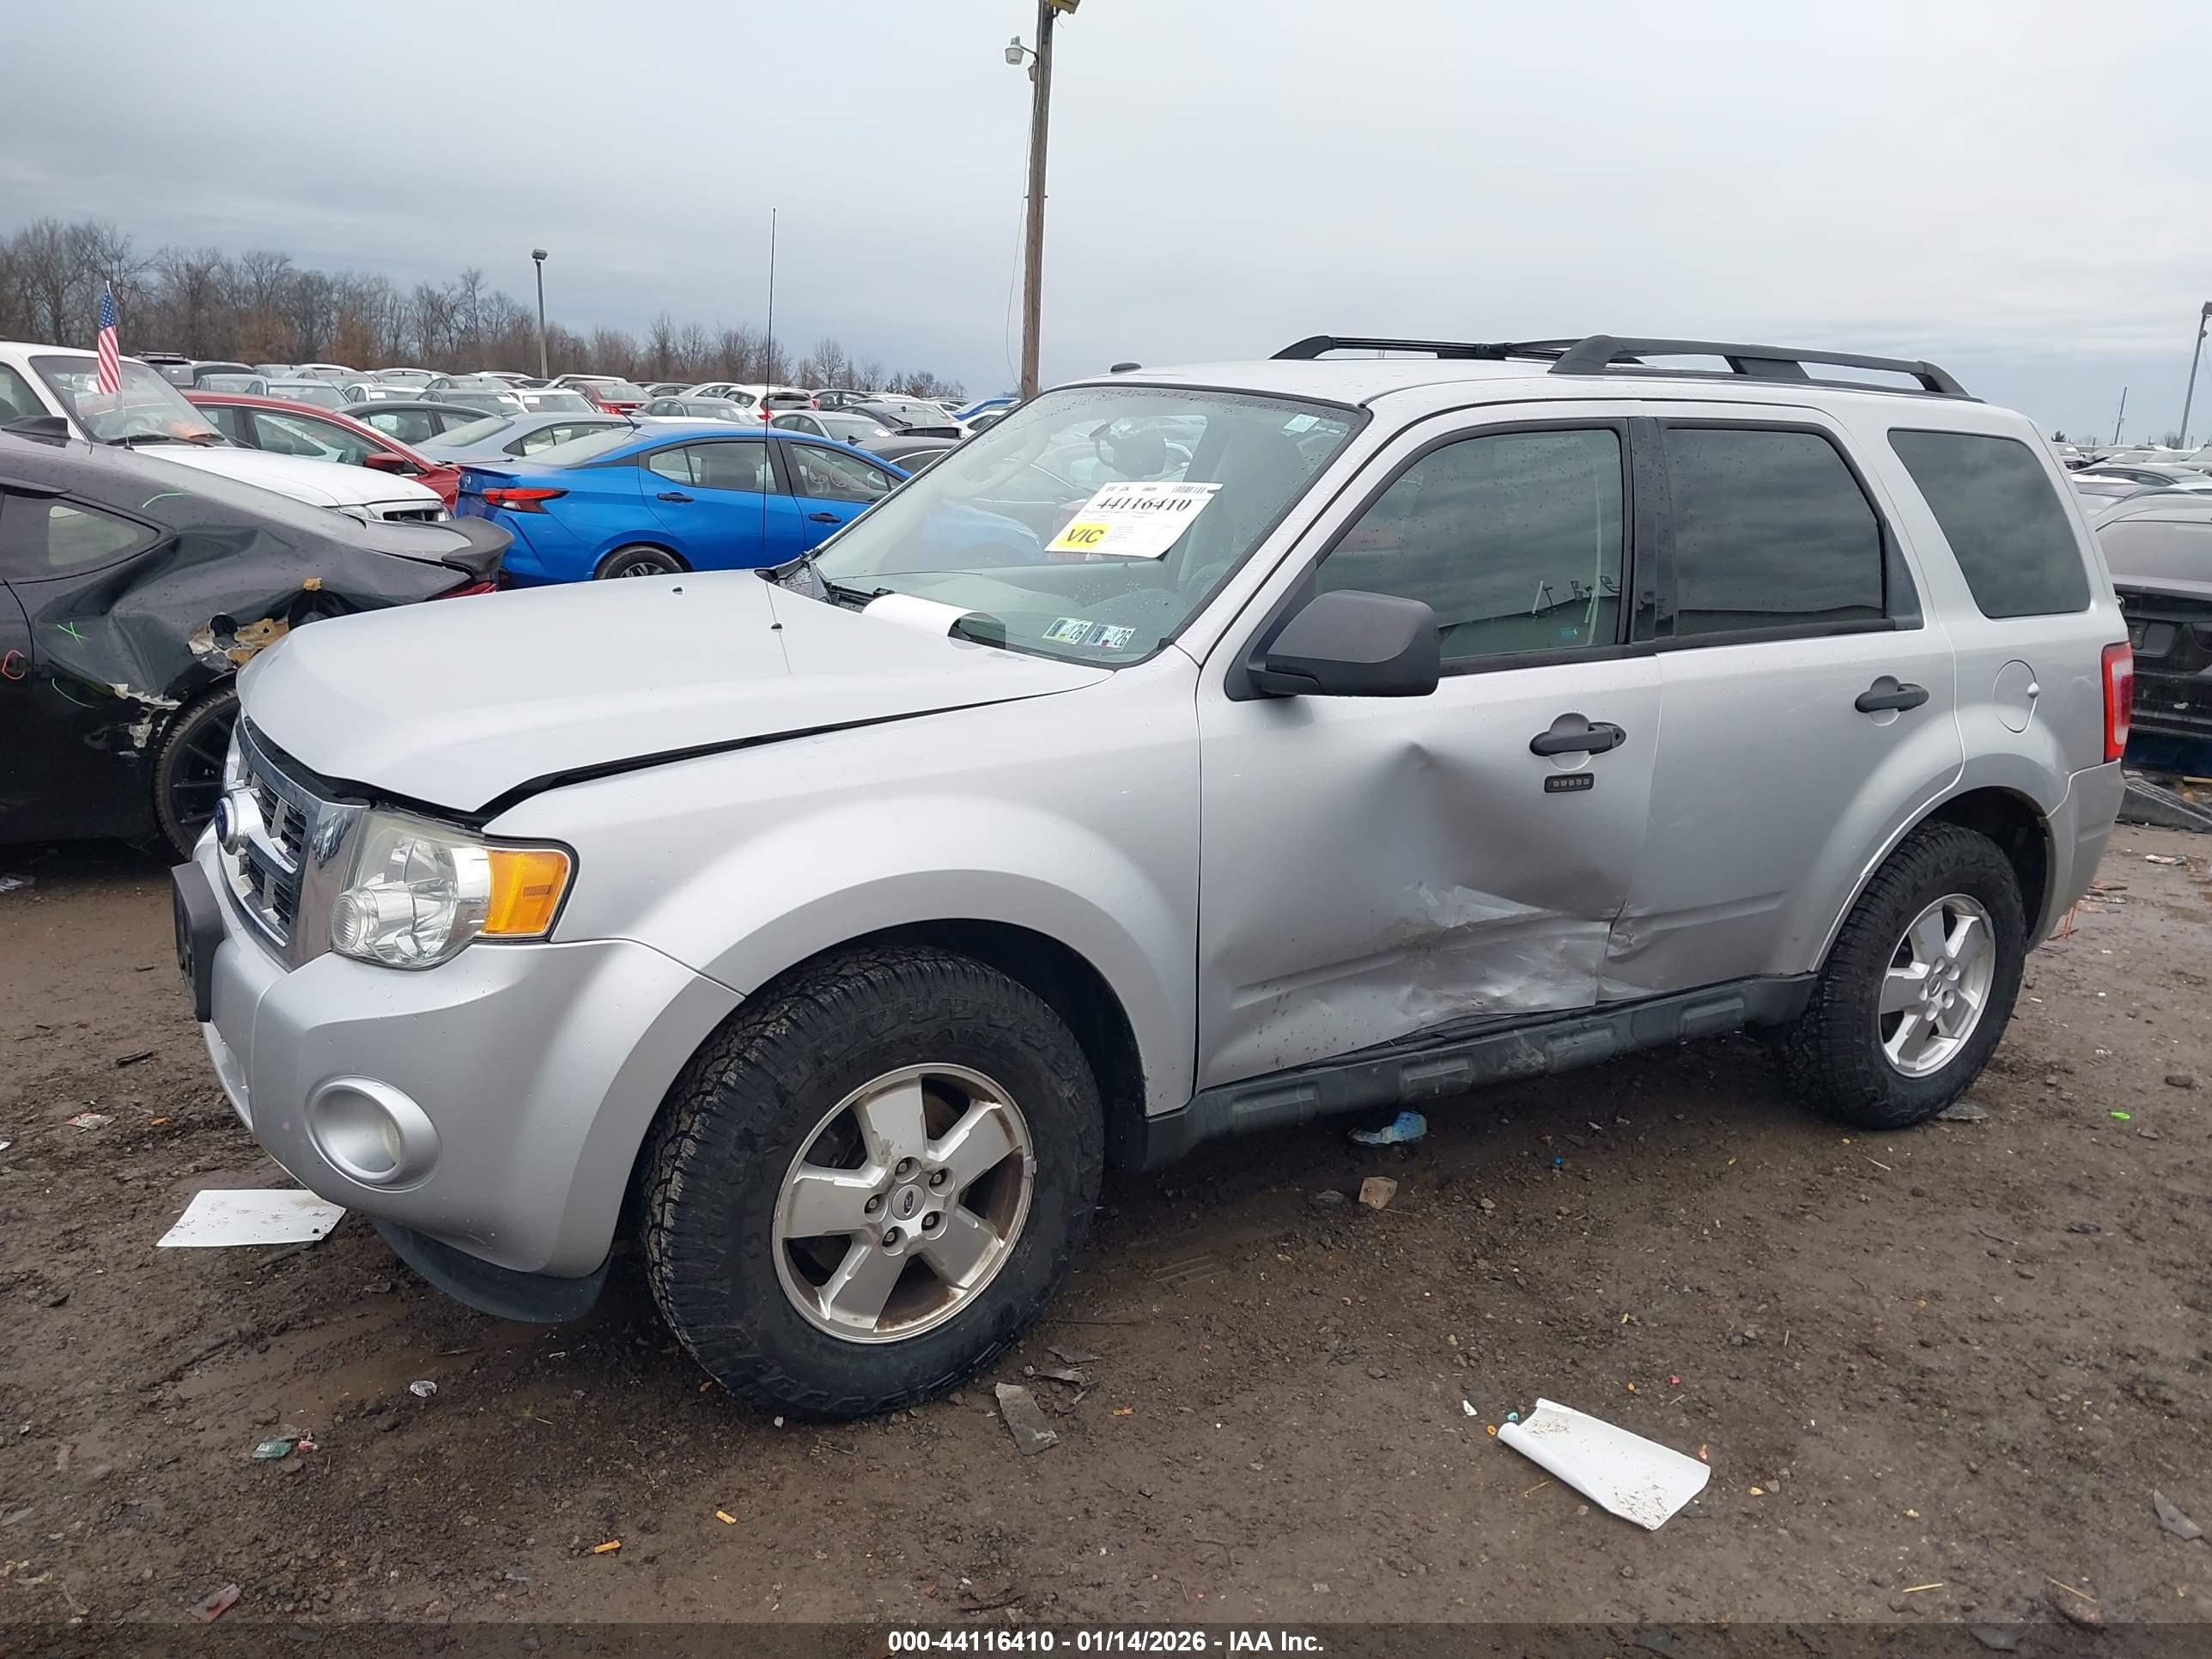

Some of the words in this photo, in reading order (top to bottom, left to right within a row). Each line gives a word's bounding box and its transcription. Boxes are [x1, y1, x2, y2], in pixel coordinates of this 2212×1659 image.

[1097, 496, 1192, 512] 44116410
[1067, 529, 1104, 543] VIC
[1070, 624, 1088, 640] 26
[1114, 629, 1132, 647] 26
